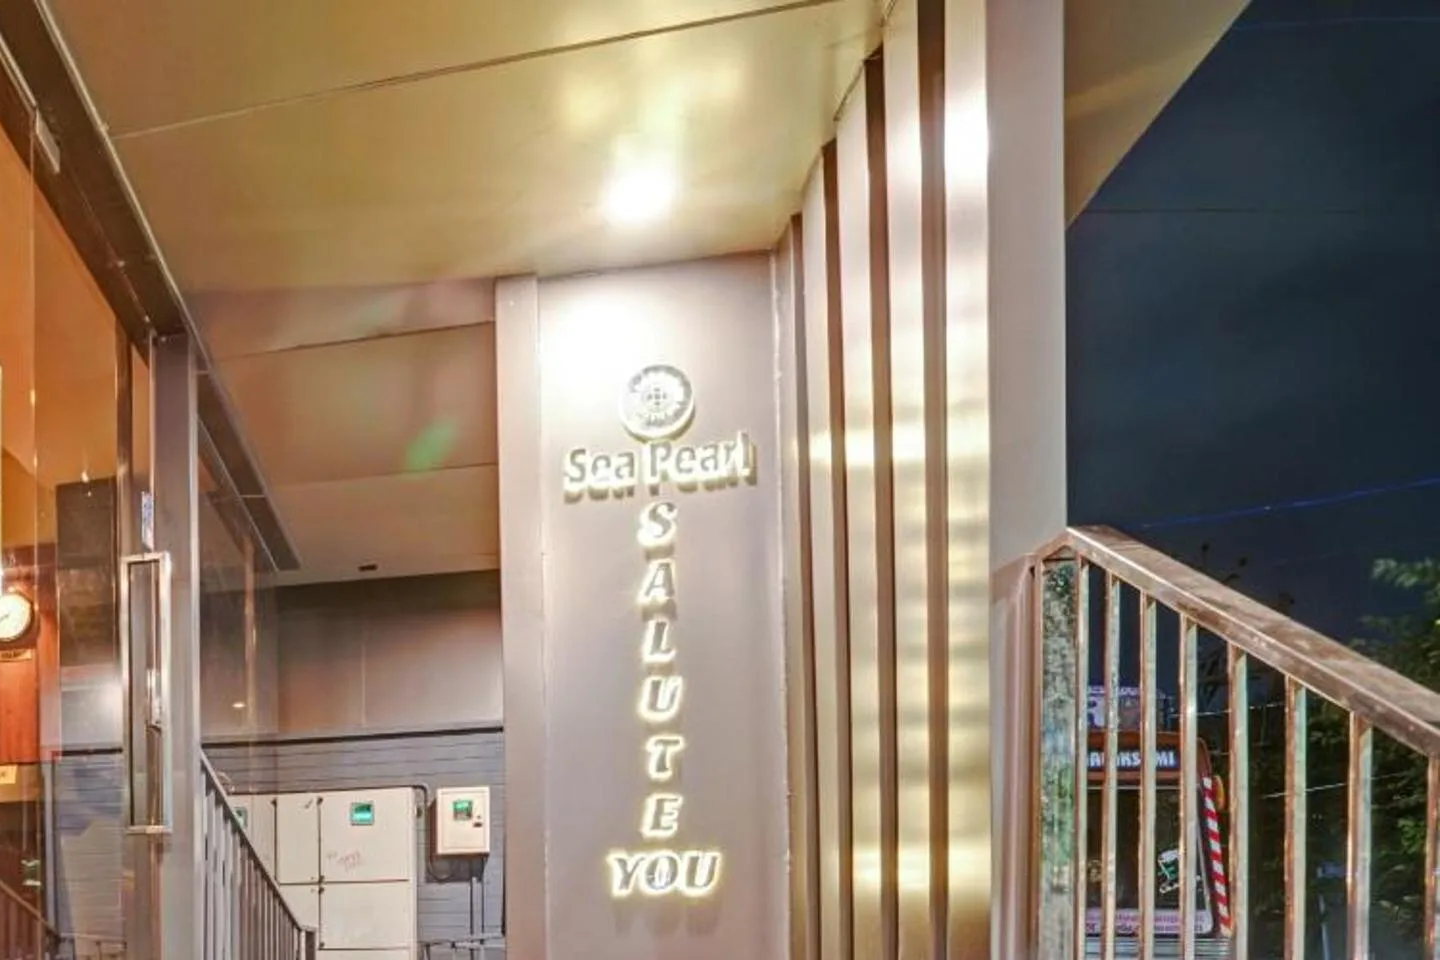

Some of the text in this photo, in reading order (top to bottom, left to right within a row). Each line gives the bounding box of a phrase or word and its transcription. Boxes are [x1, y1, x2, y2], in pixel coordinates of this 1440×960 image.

[564, 431, 754, 494] Sea Pearl
[636, 501, 684, 838] SALUTE
[605, 850, 722, 897] YOU
